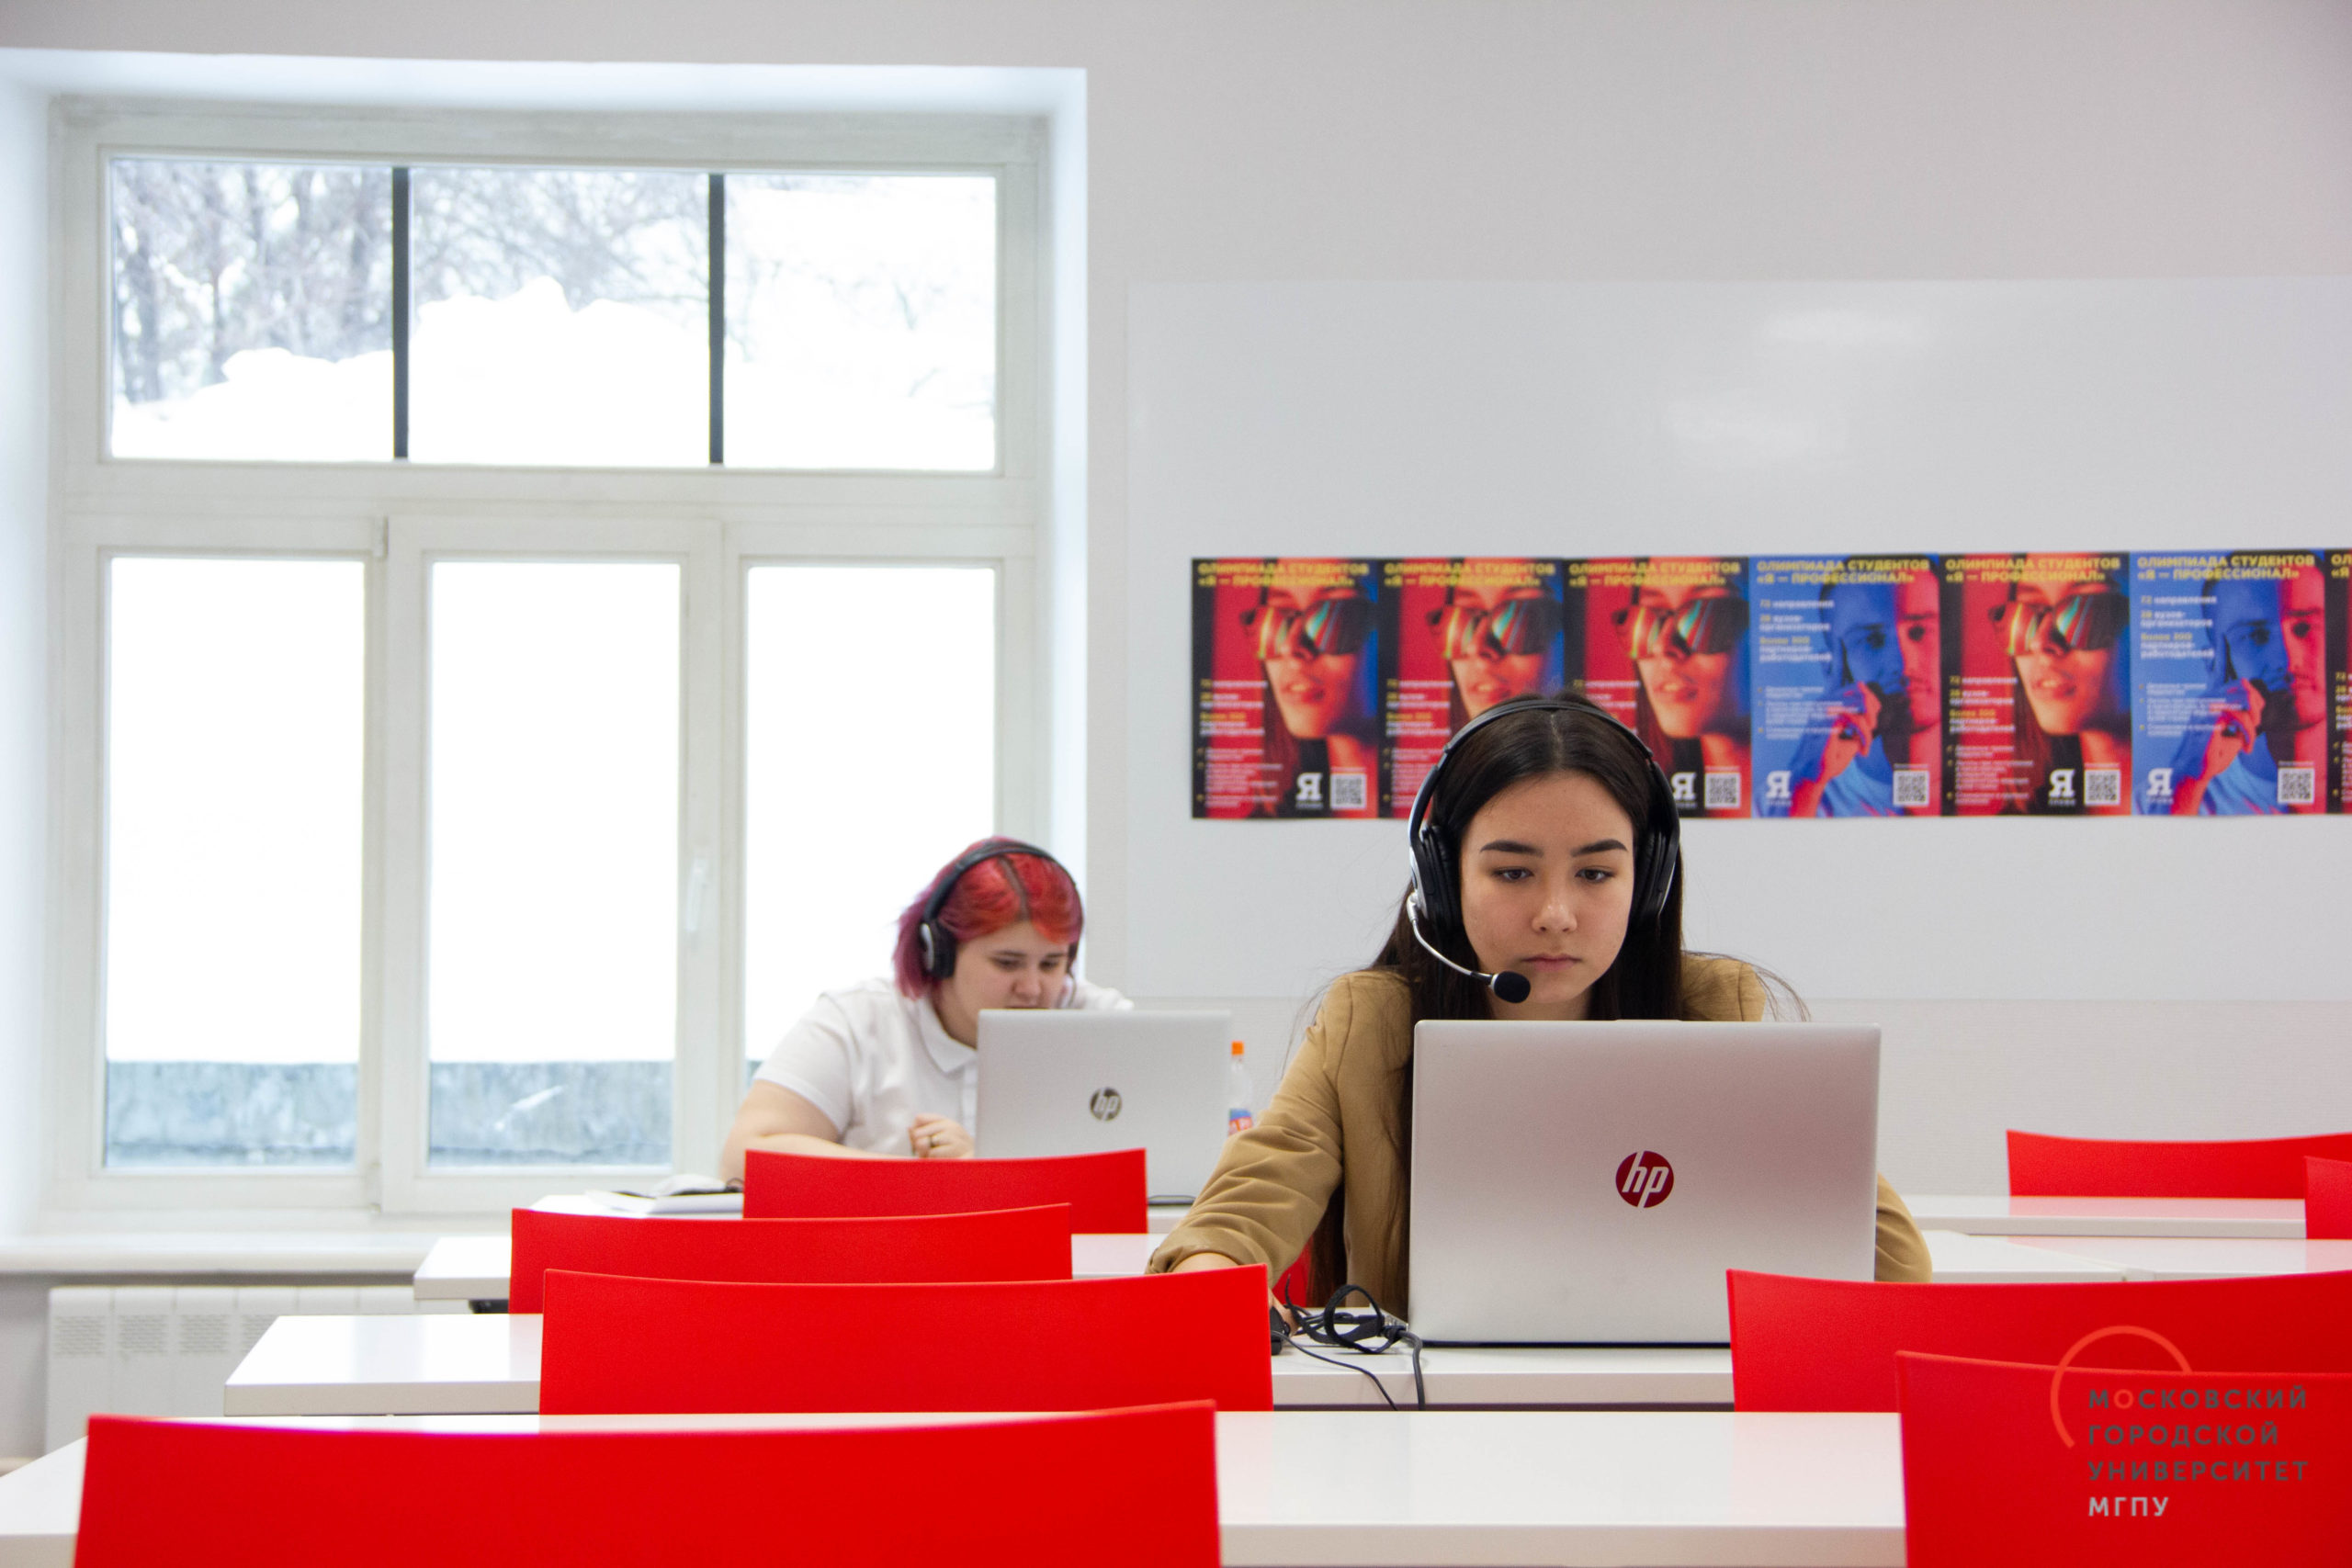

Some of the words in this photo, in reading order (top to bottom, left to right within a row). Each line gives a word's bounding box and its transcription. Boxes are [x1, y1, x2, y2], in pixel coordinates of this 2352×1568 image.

[1757, 559, 1844, 572] ОЛИМПИАДА
[1848, 559, 1929, 572] СТУДЕНТОВ
[1945, 558, 2034, 570] ОЛИМПИАДА
[2037, 558, 2120, 570] СТУДЕНТОВ
[2137, 555, 2227, 568] ОЛИМПИАДА
[2231, 555, 2315, 568] СТУДЕНТОВ
[1295, 773, 1323, 801] Я
[1766, 770, 1792, 798] Я
[2048, 769, 2075, 798] Я
[2146, 768, 2173, 796] Я
[1091, 1088, 1121, 1121] hp
[1619, 1150, 1671, 1208] hp
